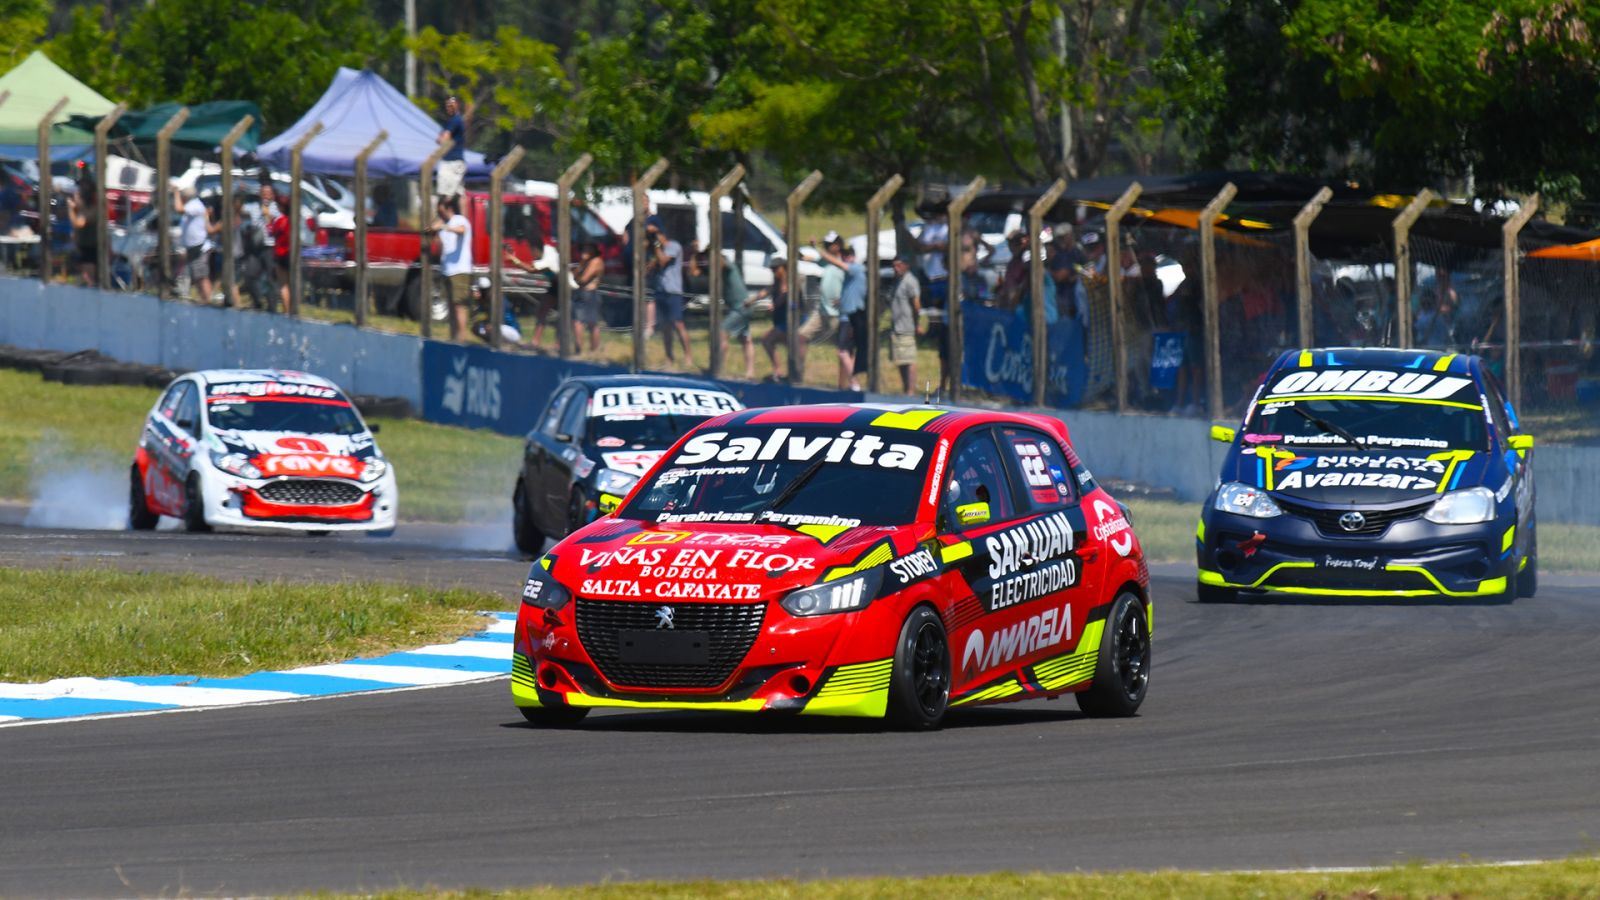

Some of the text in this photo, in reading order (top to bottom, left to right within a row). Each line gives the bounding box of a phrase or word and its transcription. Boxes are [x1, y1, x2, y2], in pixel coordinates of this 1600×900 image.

[602, 391, 736, 411] DECKER
[675, 428, 923, 470] Salvita
[1284, 435, 1365, 445] Parabriss
[1367, 435, 1449, 448] Pergamino
[266, 456, 355, 474] rave
[656, 511, 861, 528] Parabrisas Pergamino
[986, 511, 1074, 580] SAN JUAN
[580, 547, 816, 571] VIÑAS EN FLOR
[889, 549, 938, 583] STOREY
[639, 566, 718, 580] BODEGA
[523, 579, 543, 599] 22
[580, 579, 643, 597] SALTA
[654, 580, 762, 600] CAFAYATE
[991, 558, 1076, 610] ELECTRICIDAD
